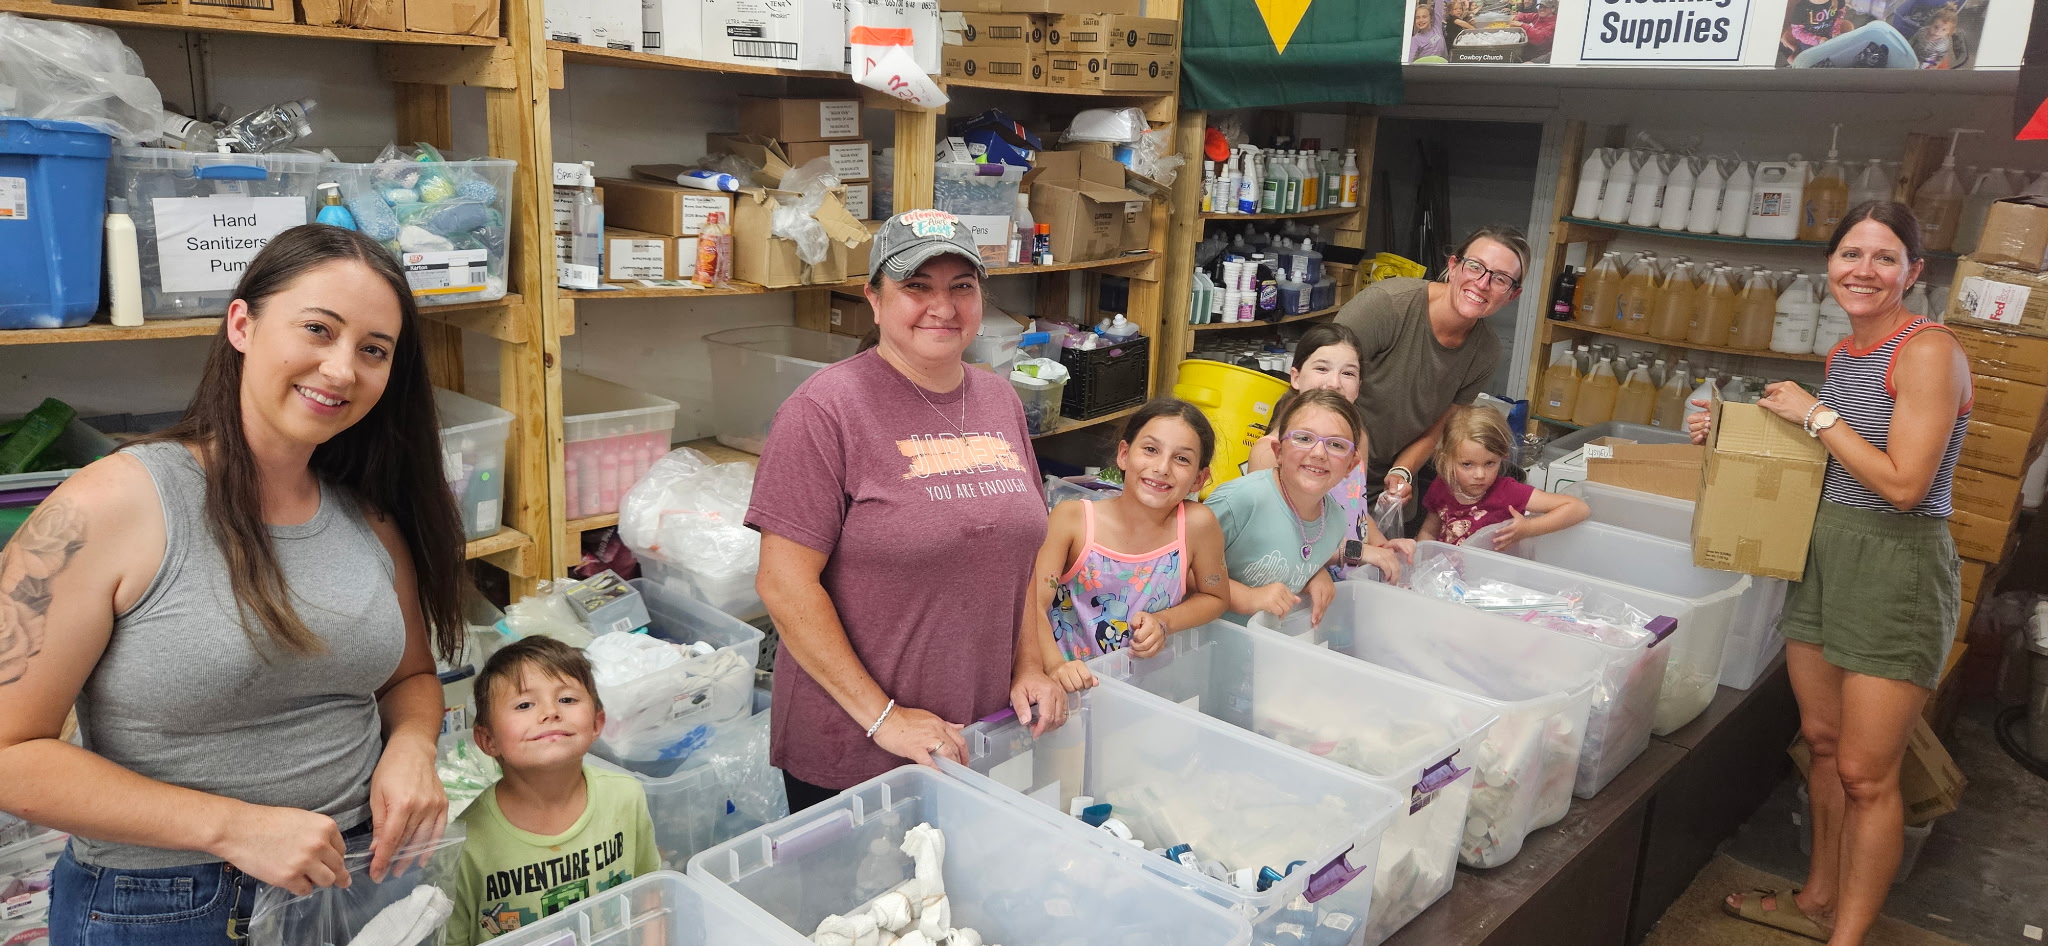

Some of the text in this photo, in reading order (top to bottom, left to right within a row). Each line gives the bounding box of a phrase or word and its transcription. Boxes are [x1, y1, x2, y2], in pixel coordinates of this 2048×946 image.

[1600, 10, 1730, 49] Supplies
[556, 168, 584, 180] Spanish
[213, 213, 257, 228] Hand
[917, 221, 951, 236] Easy
[971, 226, 988, 235] Pens
[186, 236, 268, 251] Sanitizers
[211, 259, 249, 272] Pum
[1989, 288, 2010, 321] FedEx
[909, 432, 1022, 478] JIREH
[926, 478, 1028, 501] YOU ARE ENOUGH
[1289, 574, 1307, 586] KID
[486, 831, 624, 902] ADVENTURE CLUB
